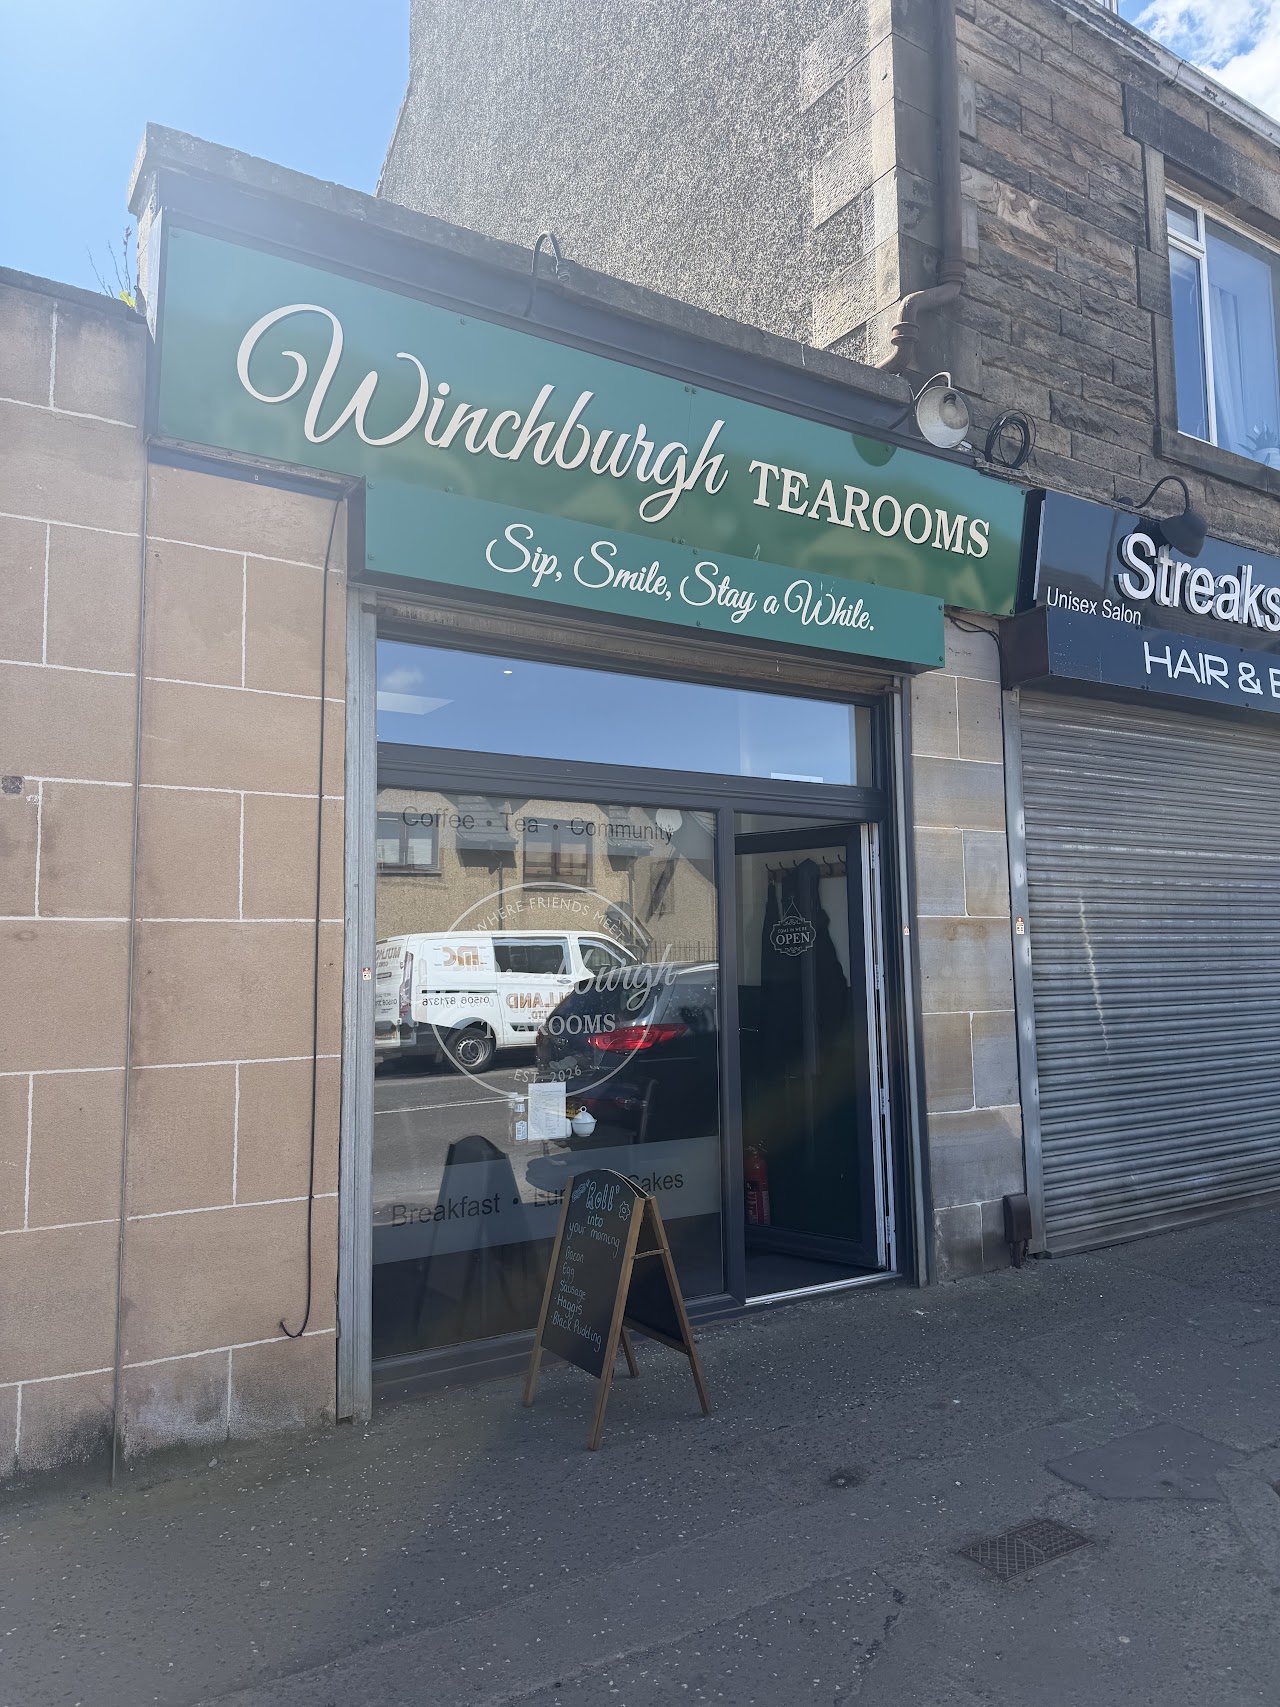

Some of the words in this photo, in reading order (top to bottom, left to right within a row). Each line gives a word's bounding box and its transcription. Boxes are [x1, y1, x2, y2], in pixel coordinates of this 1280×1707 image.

[237, 303, 729, 523] Winchburgh
[748, 459, 991, 560] TEAROOMS
[485, 523, 563, 587] Sip,
[573, 540, 673, 603] Smile,
[679, 561, 757, 624] Stay
[763, 596, 780, 616] a
[784, 580, 876, 633] While.
[1113, 532, 1280, 632] Streaks
[1047, 586, 1098, 616] Unisex
[1102, 599, 1142, 625] Salon
[1143, 641, 1230, 689] HAIR
[1238, 662, 1264, 695] &
[402, 806, 475, 829] Coffee
[500, 812, 539, 833] Tea
[570, 817, 674, 845] Community
[472, 900, 525, 935] WHERE
[529, 896, 590, 917] FRIENDS
[592, 911, 626, 941] MEET
[776, 931, 810, 945] OPEN
[549, 1065, 582, 1084] 2026
[392, 1192, 501, 1228] Breakfast
[587, 1211, 604, 1228] into
[565, 1245, 584, 1264] Bacon
[566, 1222, 587, 1241] your
[590, 1228, 620, 1259] morning
[559, 1279, 586, 1304] Sausage
